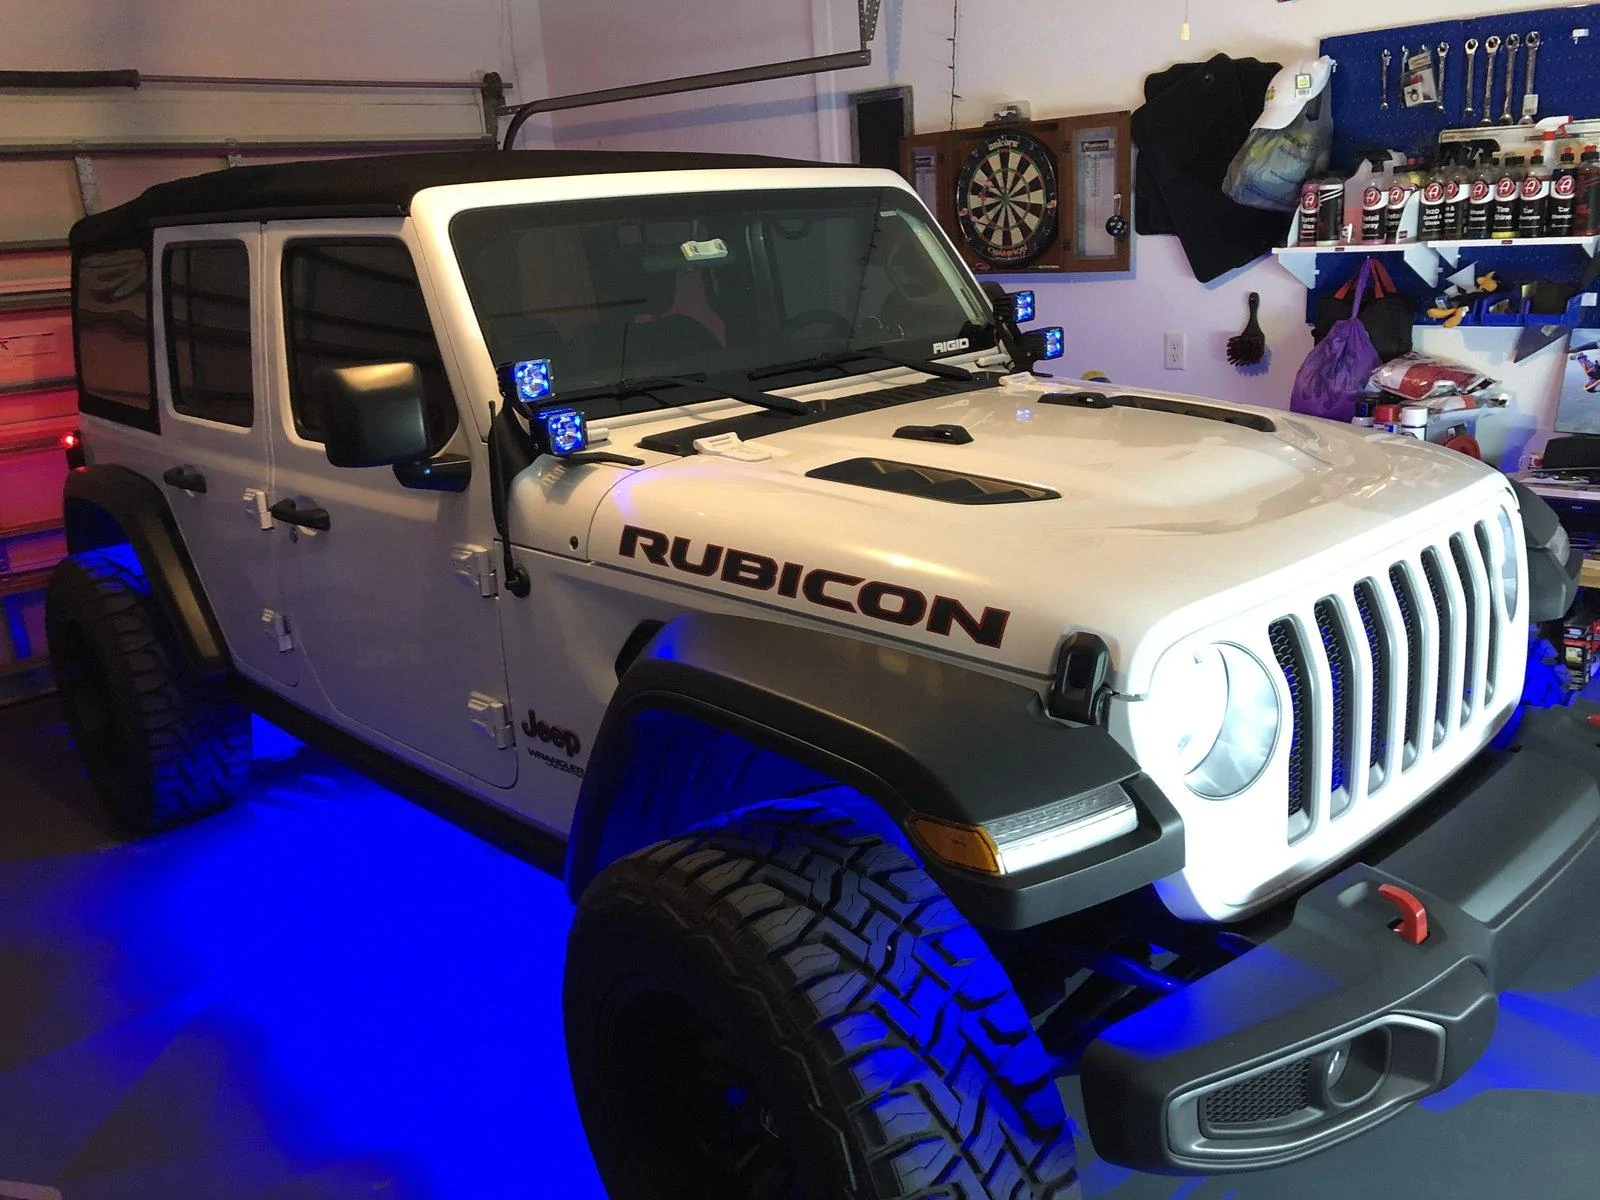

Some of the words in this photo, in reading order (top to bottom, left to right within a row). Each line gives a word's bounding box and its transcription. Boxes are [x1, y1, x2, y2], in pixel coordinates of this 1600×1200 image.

[932, 337, 970, 355] RIGID
[618, 524, 1011, 649] RUBICON
[521, 708, 581, 758] Jeep
